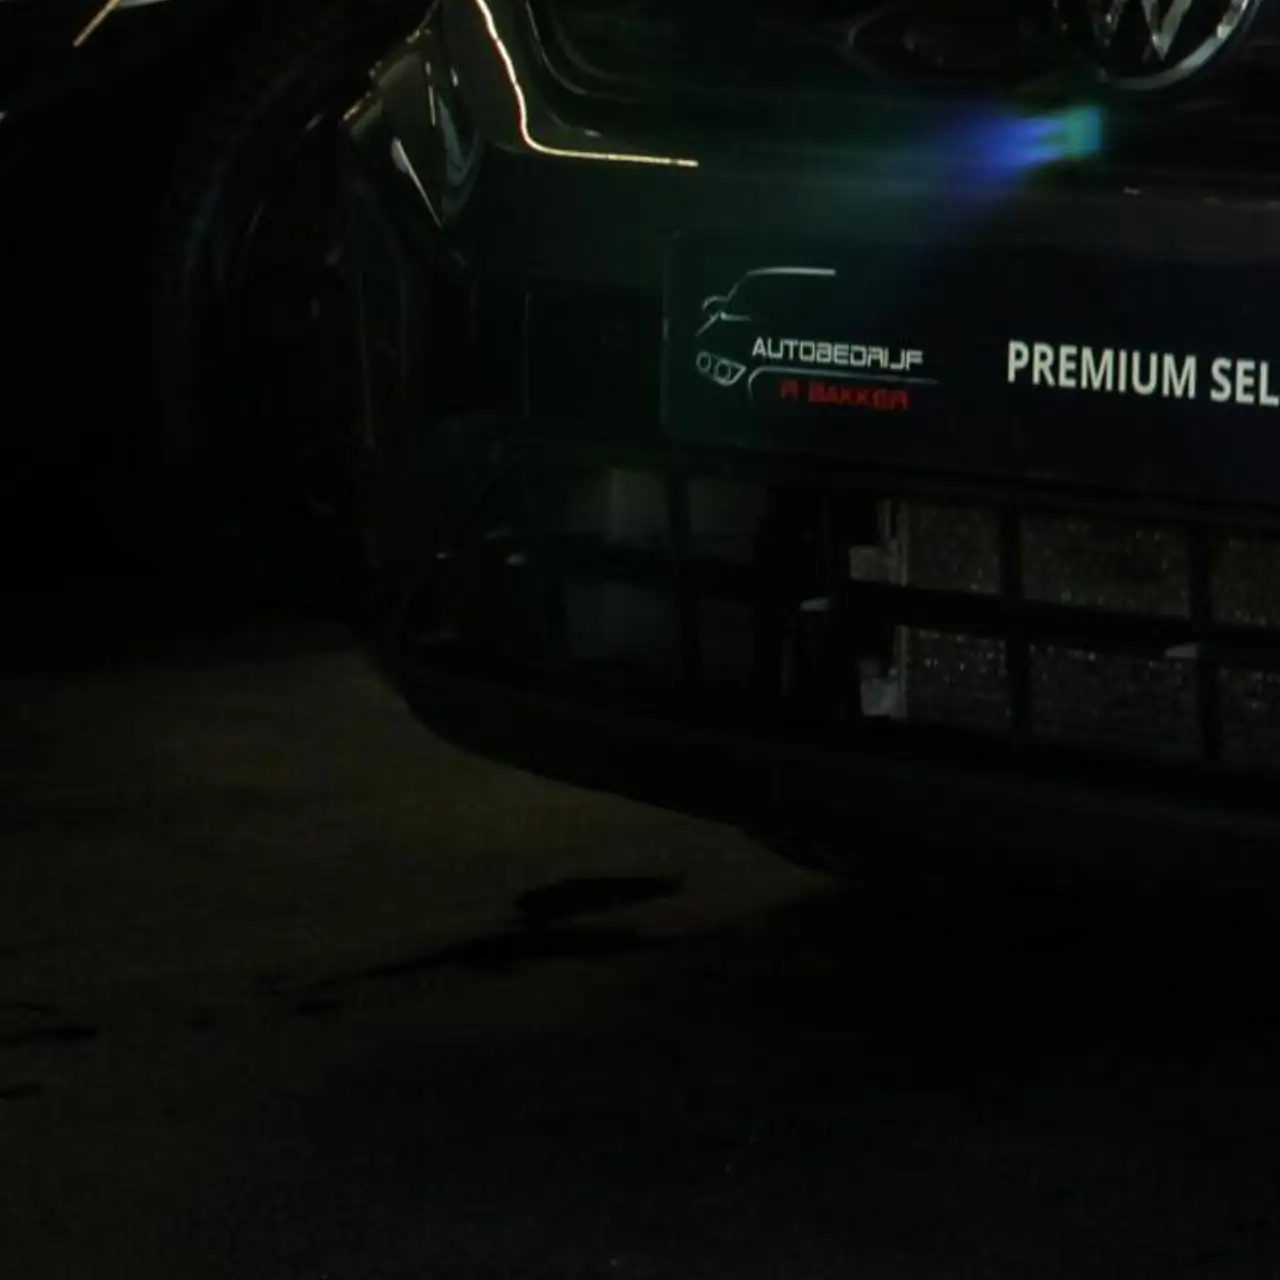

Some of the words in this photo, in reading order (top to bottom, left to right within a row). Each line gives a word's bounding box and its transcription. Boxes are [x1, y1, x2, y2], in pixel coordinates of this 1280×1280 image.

[752, 336, 924, 371] AUTOBEDRIJF
[1007, 339, 1198, 400] PREMIUM
[808, 381, 910, 413] BAKKER
